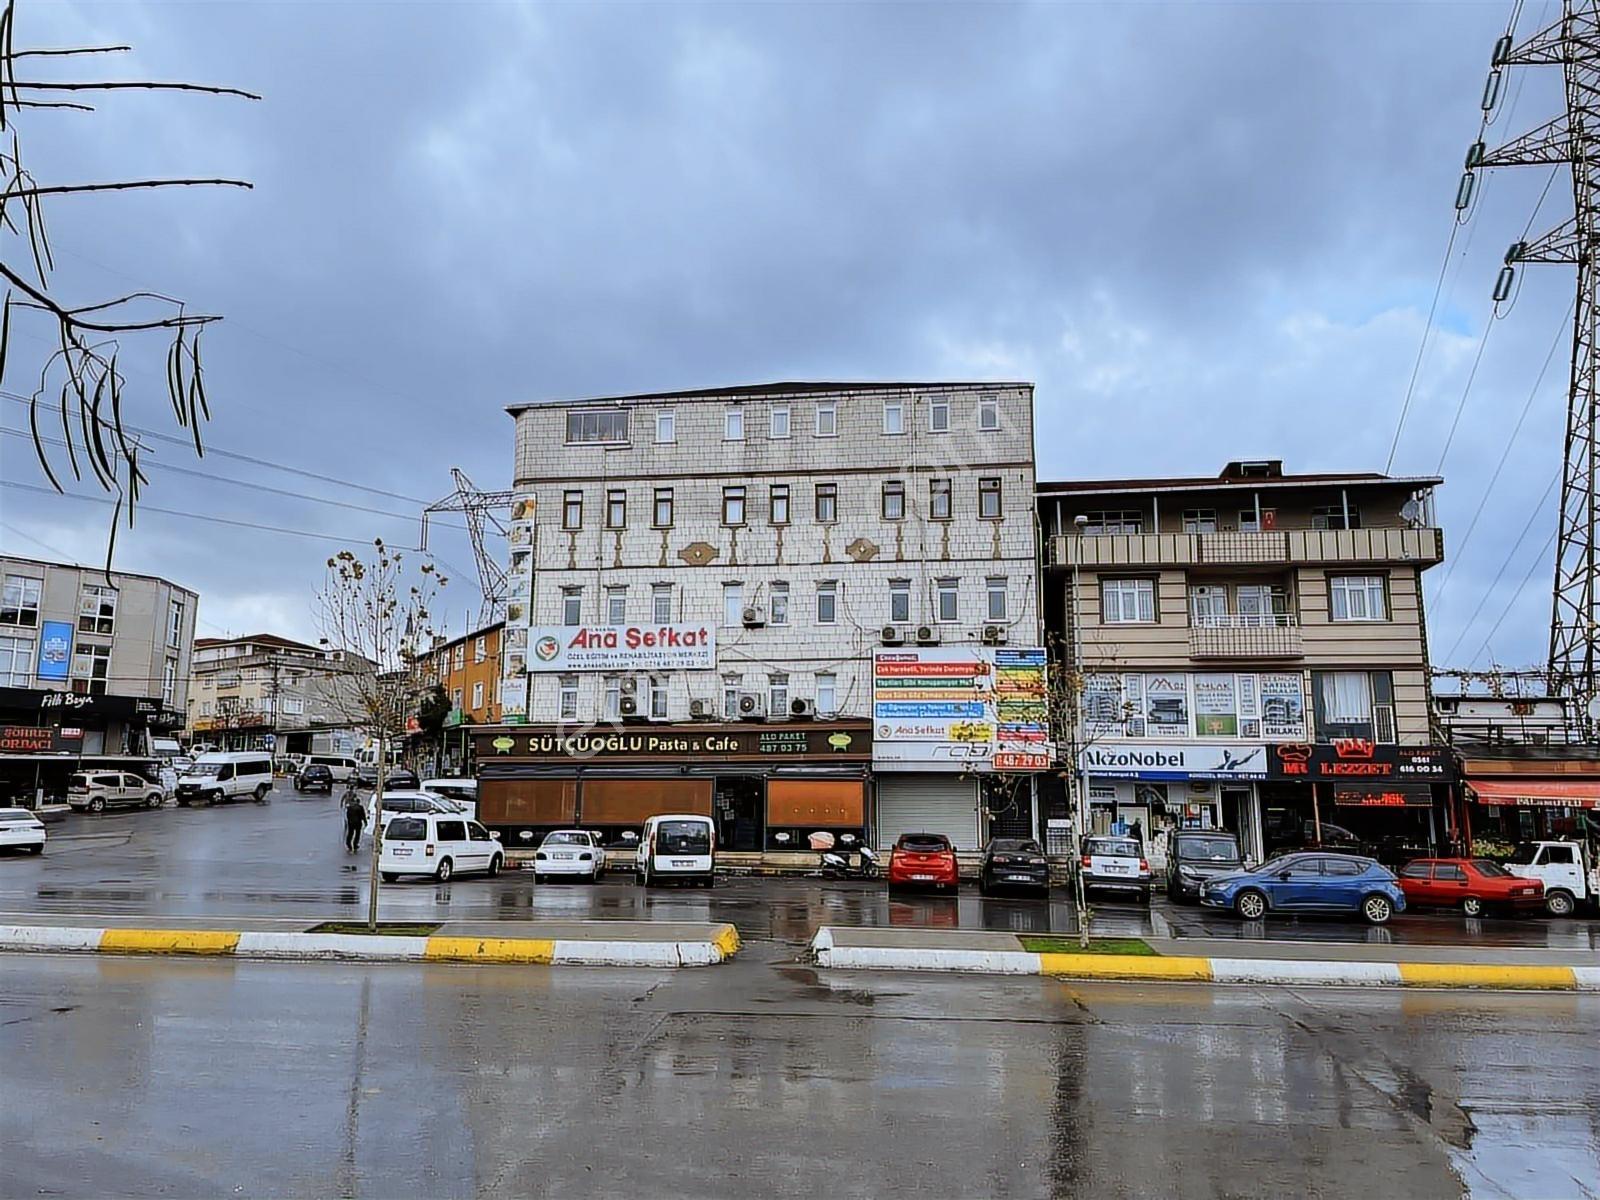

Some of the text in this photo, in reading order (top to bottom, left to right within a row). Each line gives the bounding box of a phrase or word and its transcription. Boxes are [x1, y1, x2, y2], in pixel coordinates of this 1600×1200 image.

[568, 626, 708, 650] Ana Şefkat
[649, 737, 688, 751] Pasta
[705, 736, 739, 751] Cafe
[1087, 750, 1185, 768] AkzoNobel
[1320, 762, 1392, 775] LEZZET
